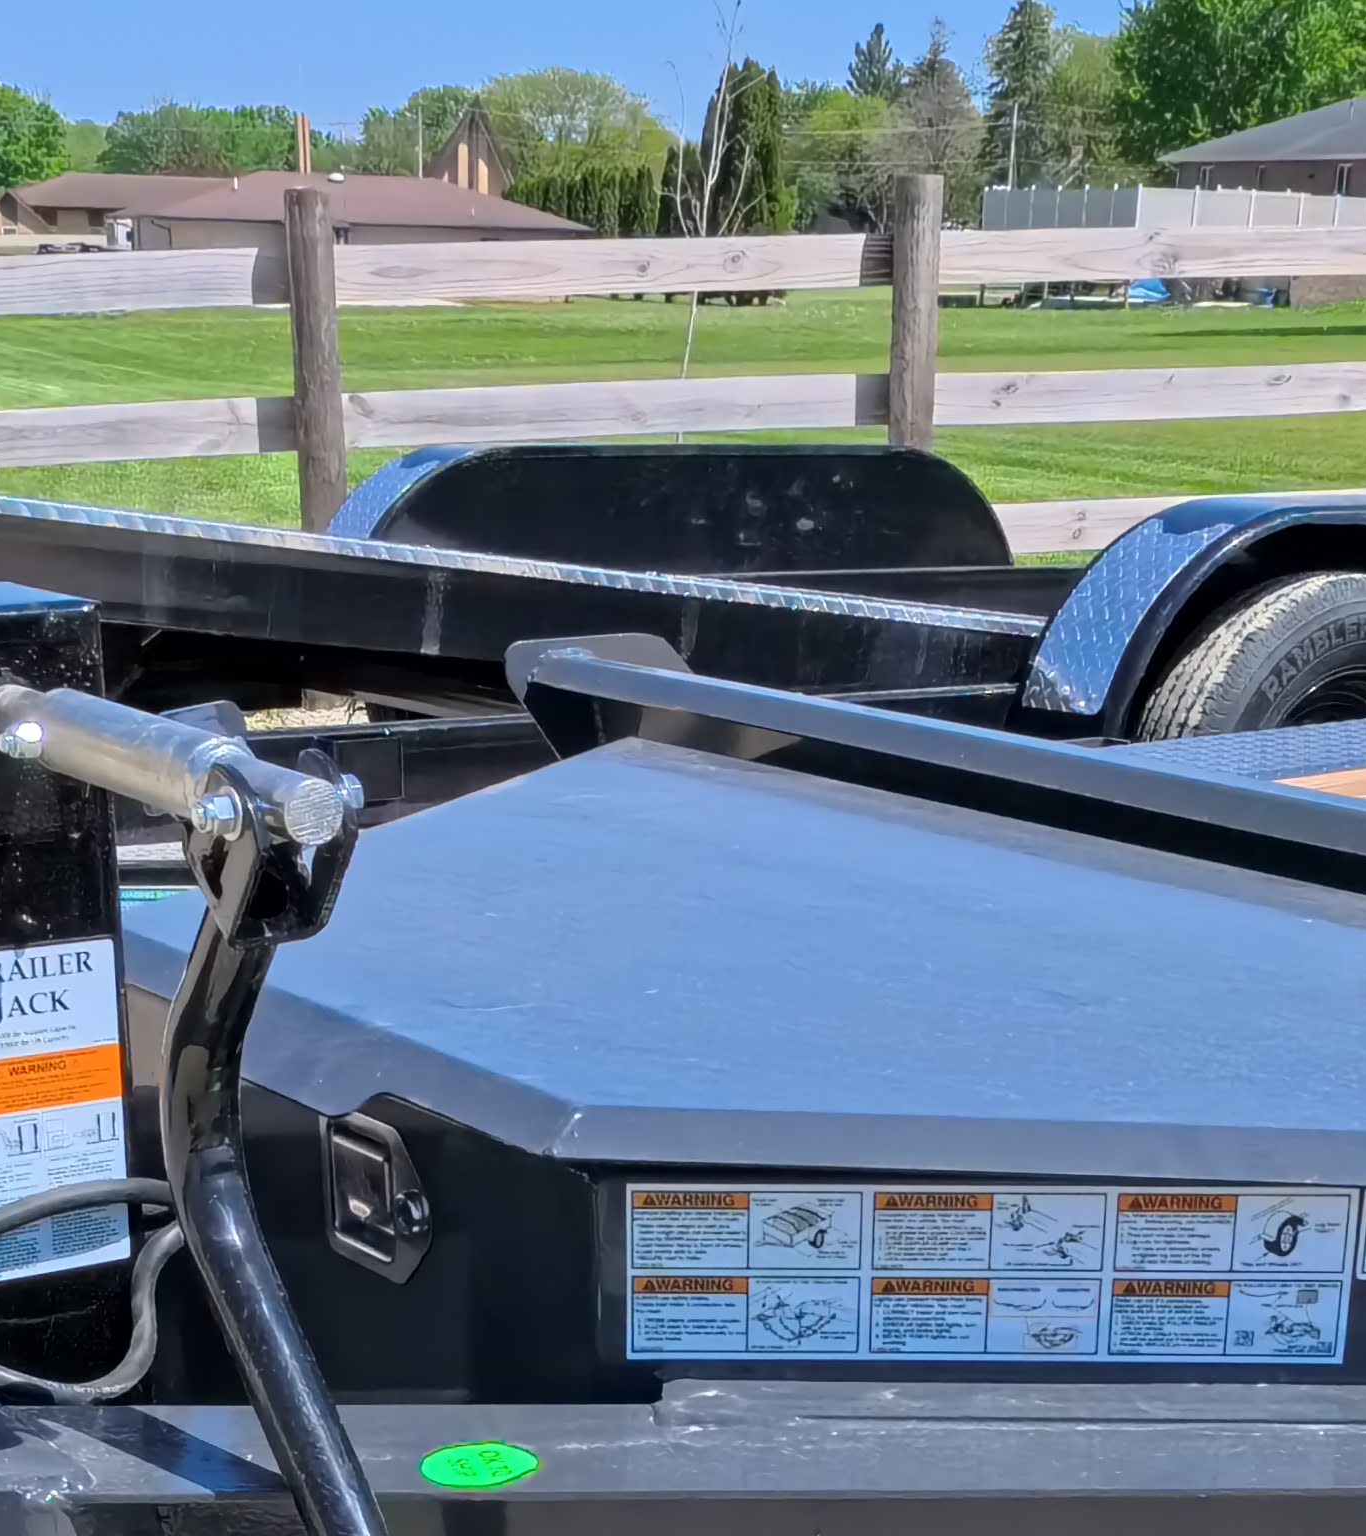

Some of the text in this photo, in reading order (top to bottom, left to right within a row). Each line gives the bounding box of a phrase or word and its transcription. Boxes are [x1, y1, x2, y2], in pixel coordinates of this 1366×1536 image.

[8, 1059, 67, 1077] WARNING
[655, 1194, 735, 1206] WARNING
[895, 1194, 978, 1208] WARNING
[1141, 1197, 1223, 1209] WARNING
[655, 1279, 735, 1291] WARNING
[895, 1280, 975, 1293] WARNING
[1137, 1282, 1216, 1294] WARNING
